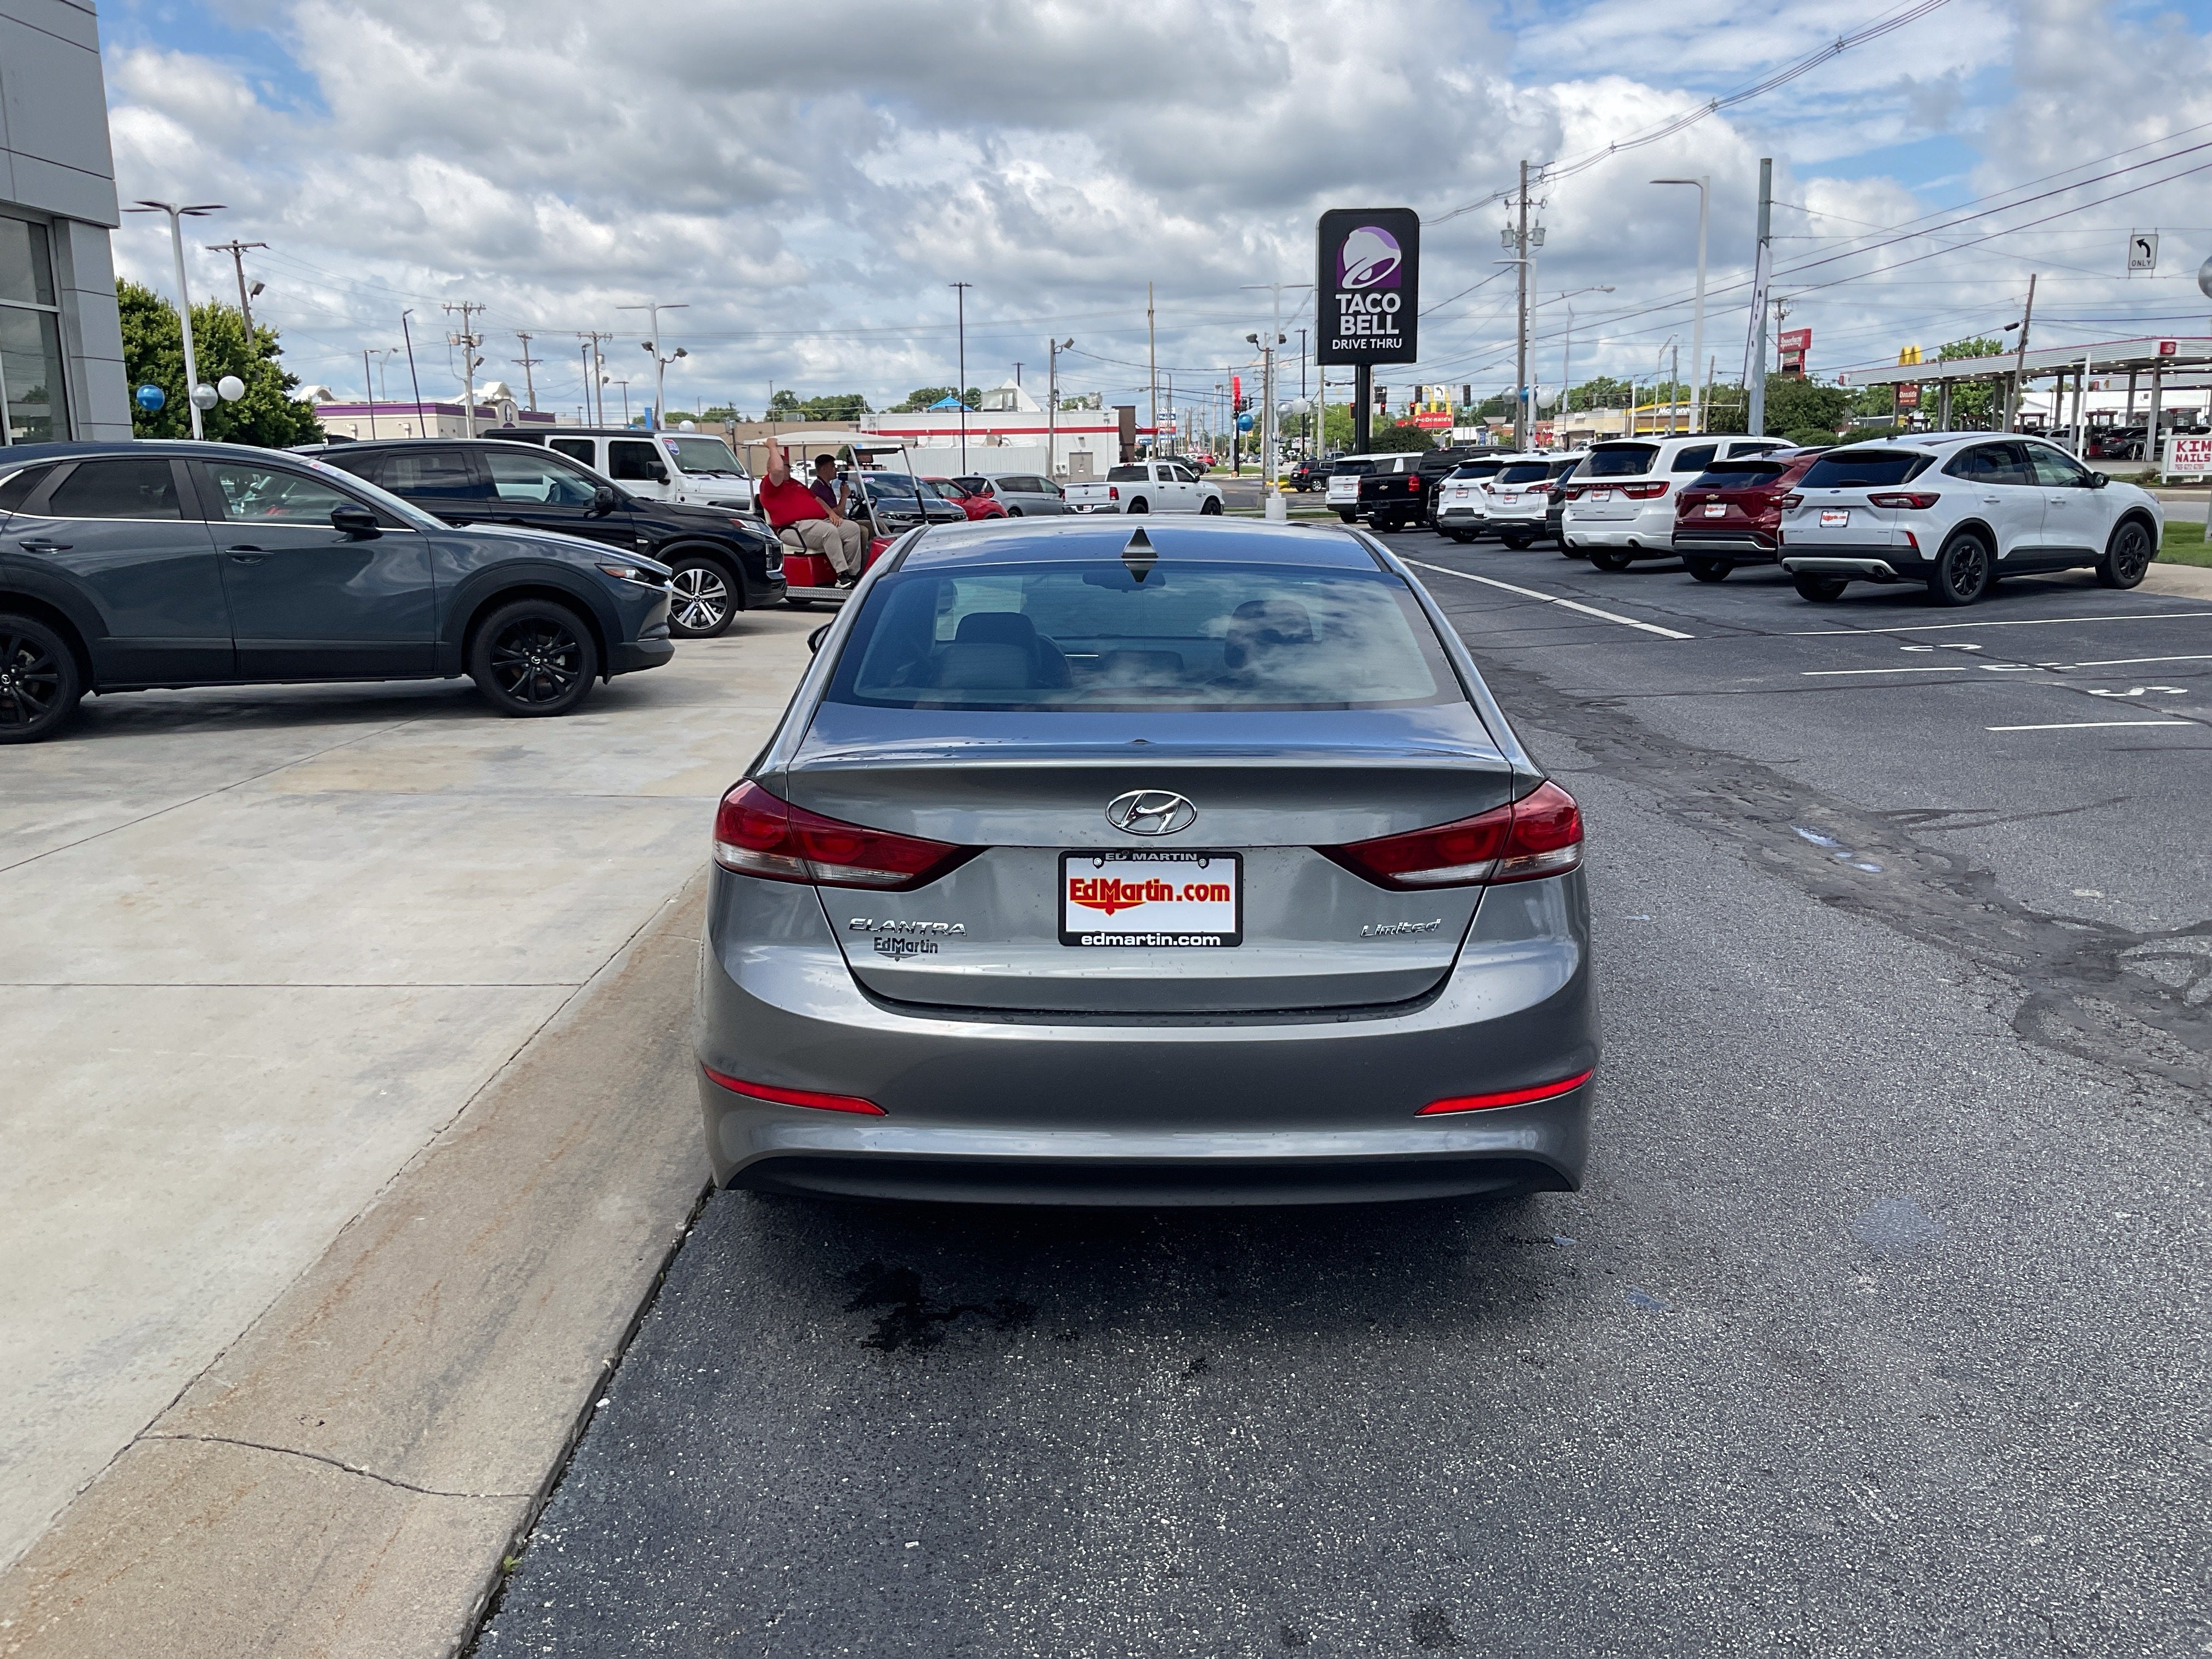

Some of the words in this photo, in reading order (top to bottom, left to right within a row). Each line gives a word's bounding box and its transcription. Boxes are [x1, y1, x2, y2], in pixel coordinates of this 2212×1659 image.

[1335, 292, 1401, 314] TACO
[1340, 314, 1400, 336] BELL
[1332, 339, 1367, 349] DRIVE
[1369, 338, 1402, 349] THRU
[2176, 440, 2212, 453] KIM
[2175, 453, 2211, 462] NAILS
[1105, 853, 1126, 861] ED
[1132, 853, 1197, 861] MARTIN
[1069, 878, 1230, 902] EdMartin.com
[849, 917, 967, 936] ELANTRA
[1360, 918, 1442, 938] Limited
[1081, 933, 1221, 946] edmartin.com
